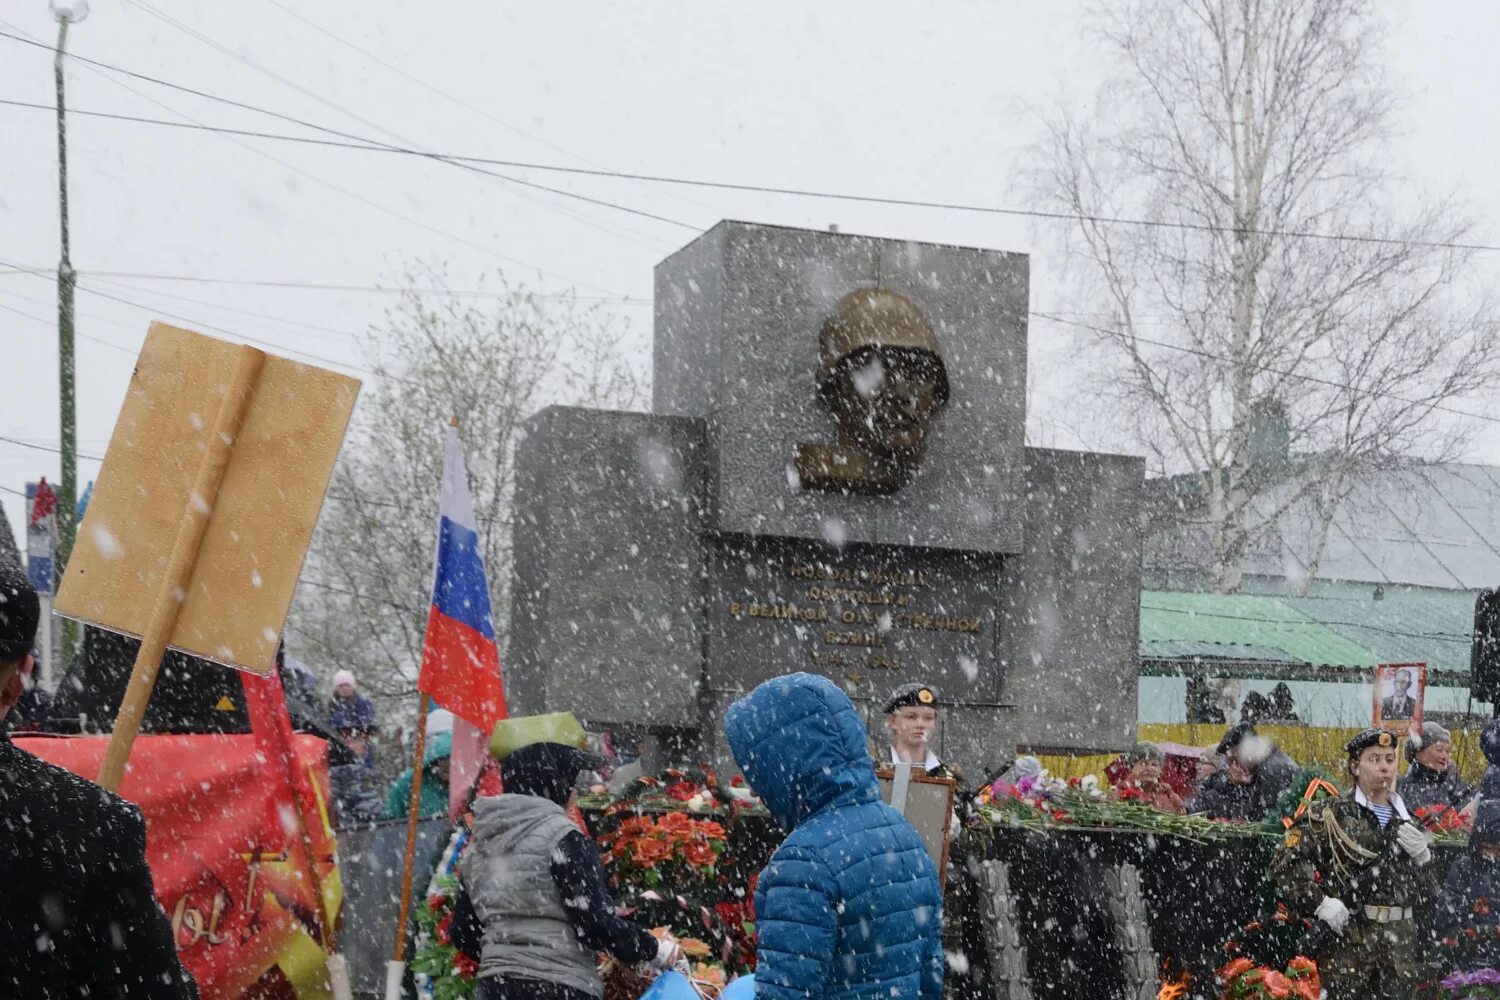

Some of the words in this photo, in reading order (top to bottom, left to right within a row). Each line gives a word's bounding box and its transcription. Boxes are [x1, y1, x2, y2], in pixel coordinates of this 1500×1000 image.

[730, 602, 741, 616] В
[748, 603, 828, 621] ВЕЛИКОЙ
[842, 609, 980, 632] ОТЕЧСТВЕННОЙ
